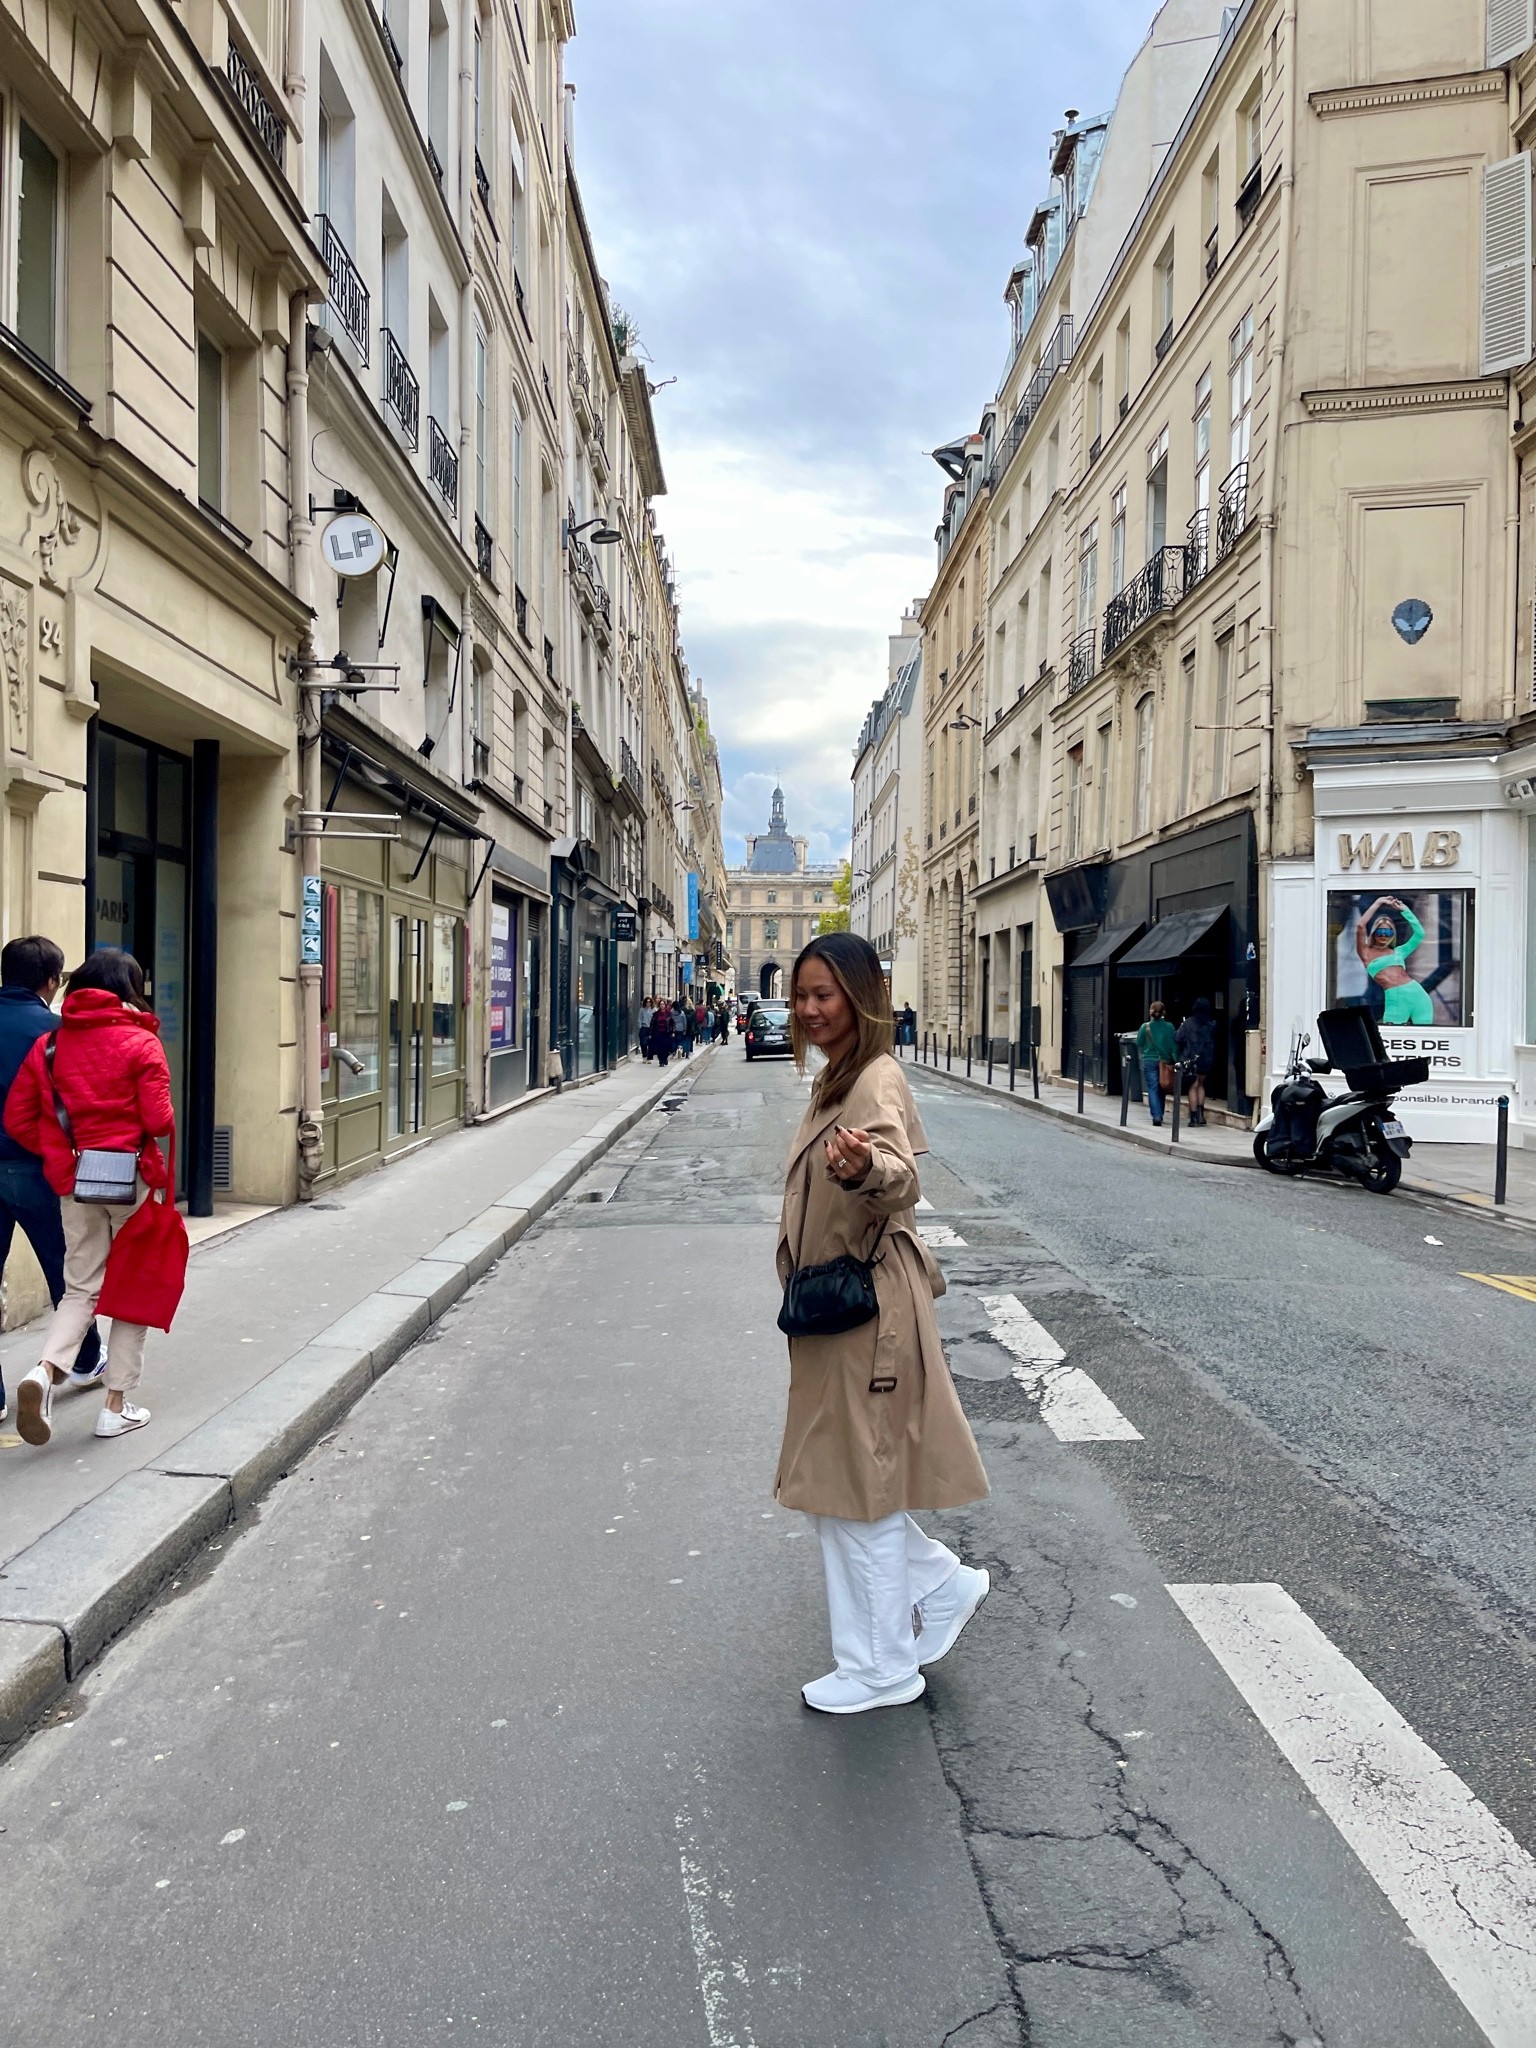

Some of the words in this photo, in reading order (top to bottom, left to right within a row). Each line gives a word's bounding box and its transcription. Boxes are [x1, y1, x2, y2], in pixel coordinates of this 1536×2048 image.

[330, 529, 374, 561] LP
[40, 615, 64, 657] 24
[1338, 831, 1461, 869] WAB
[1382, 1039, 1416, 1050] CES
[1421, 1040, 1450, 1050] DE
[1394, 1095, 1448, 1103] ponsible
